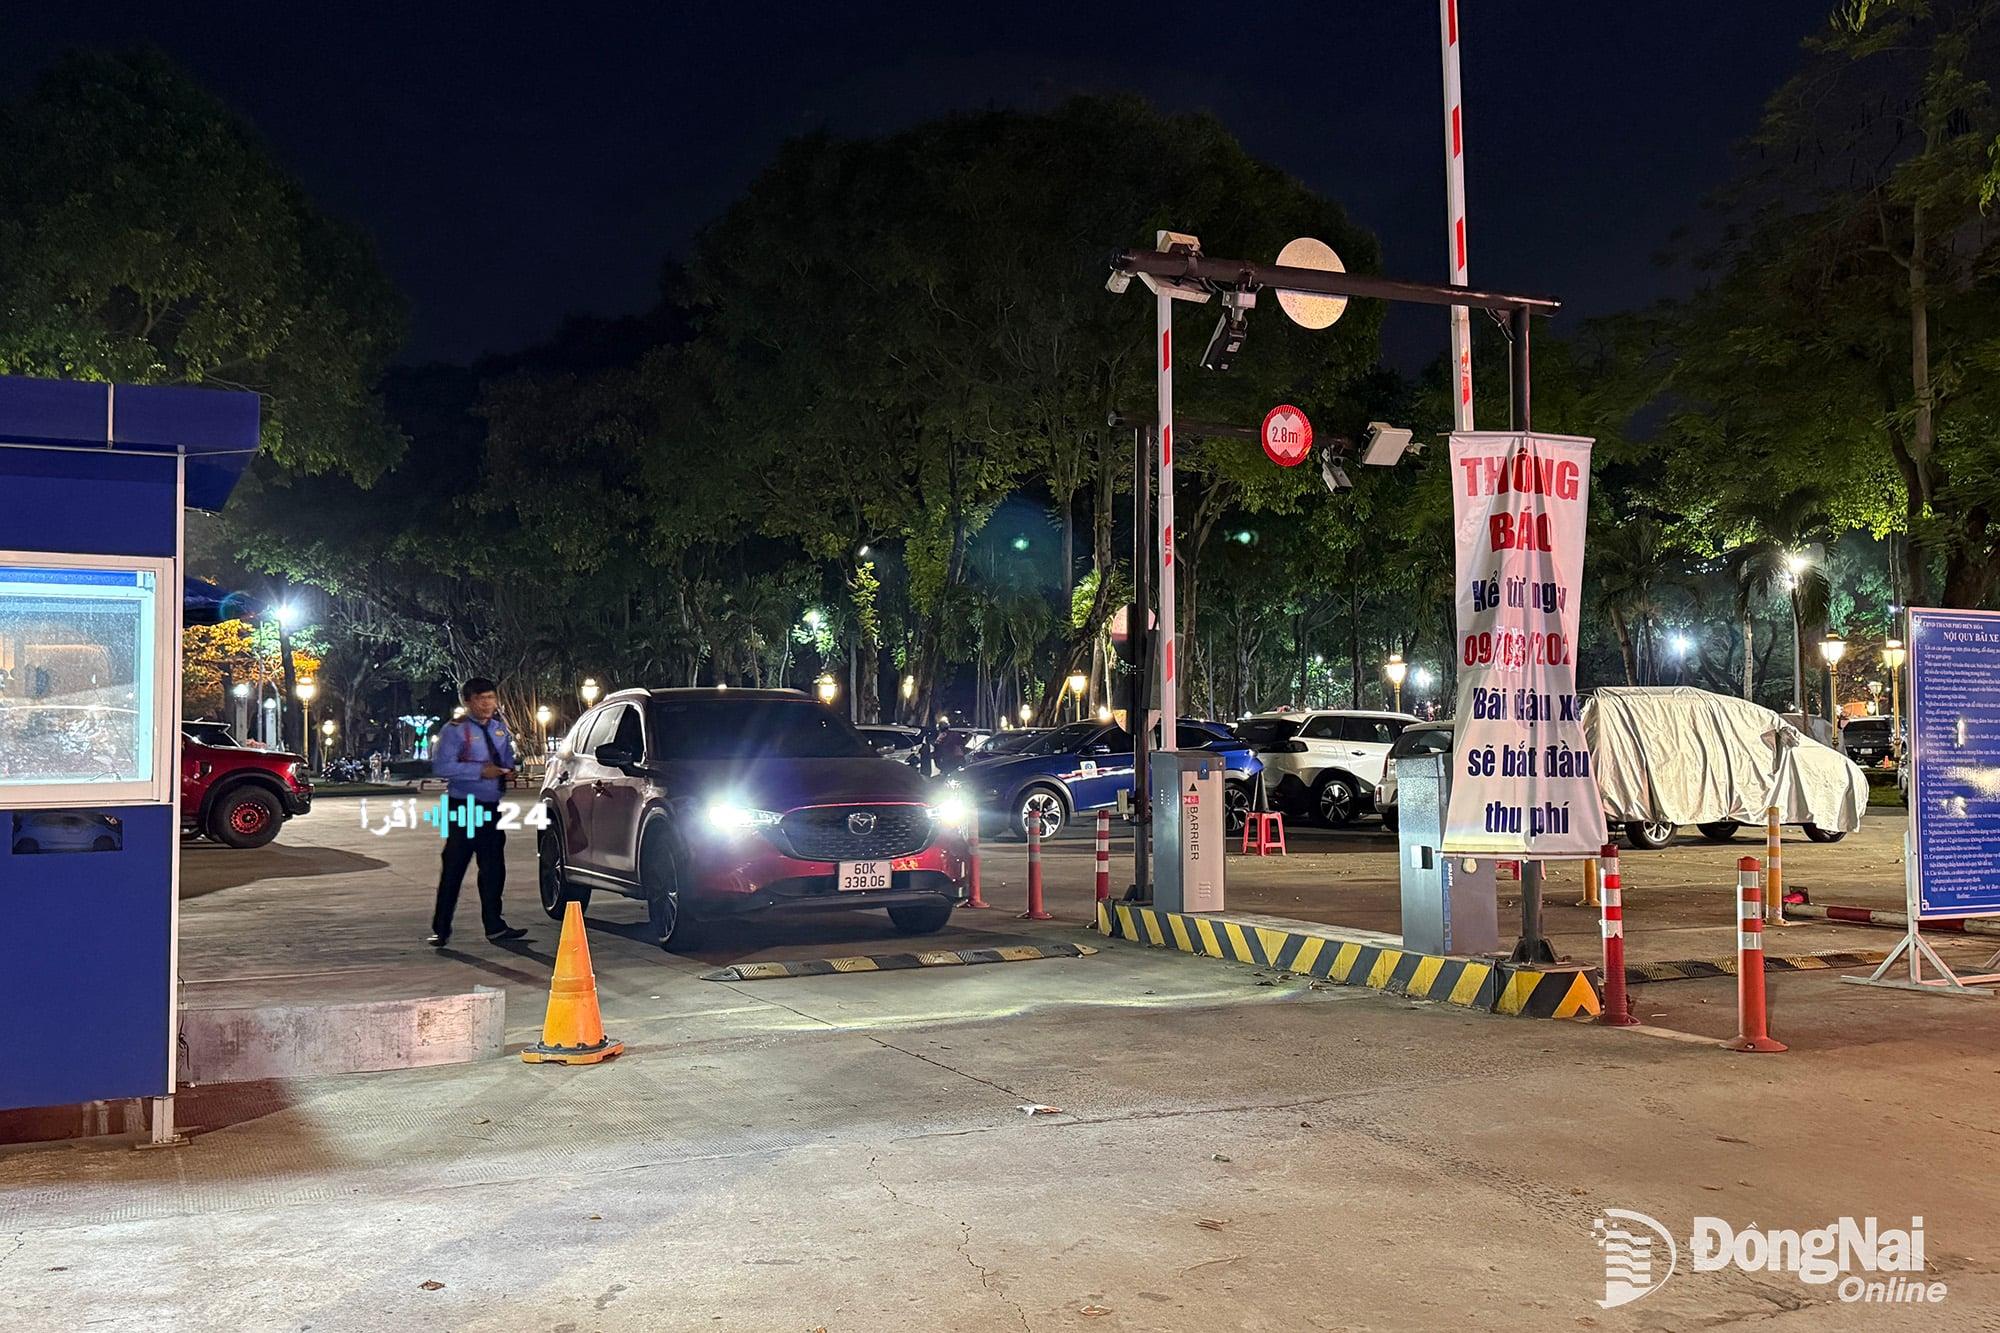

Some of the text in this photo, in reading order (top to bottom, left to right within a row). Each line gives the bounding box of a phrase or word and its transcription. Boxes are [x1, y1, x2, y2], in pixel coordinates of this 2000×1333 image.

[1272, 426, 1298, 444] 2.8m
[1460, 447, 1579, 500] THÔNG
[1489, 505, 1552, 552] BÁO
[1472, 570, 1567, 614] Kể từ ngy
[1464, 631, 1571, 667] 09/03/202
[1943, 631, 2000, 643] NỘI QUY BÃI XE
[1473, 687, 1508, 721] Bãi
[1514, 688, 1551, 727] đậu
[1467, 740, 1590, 778] sẽ bắt đầu
[1190, 806, 1200, 861] BARRIER
[1485, 801, 1570, 837] thu phí
[844, 875, 885, 889] 338.06
[854, 863, 877, 875] 60K
